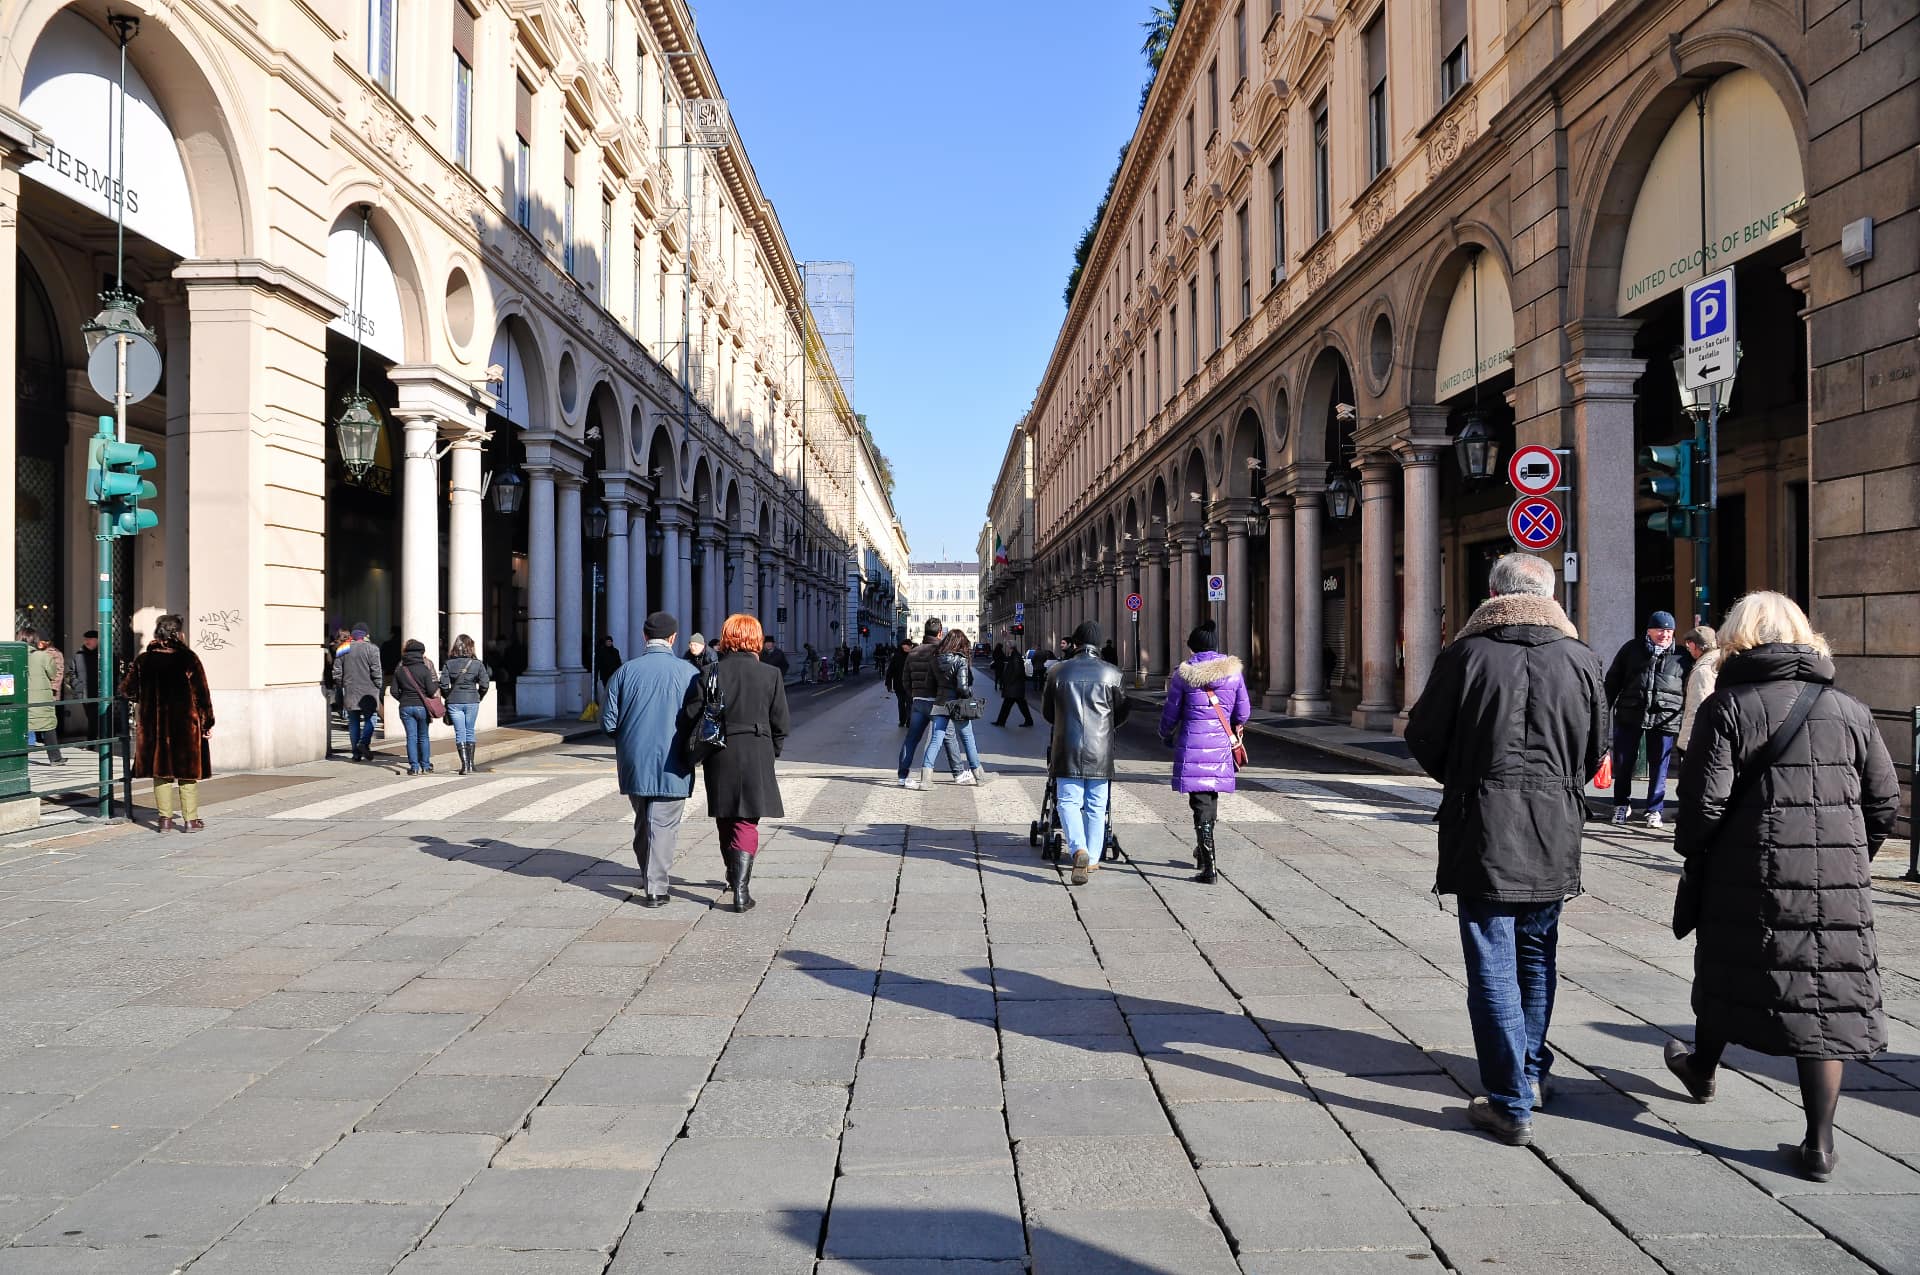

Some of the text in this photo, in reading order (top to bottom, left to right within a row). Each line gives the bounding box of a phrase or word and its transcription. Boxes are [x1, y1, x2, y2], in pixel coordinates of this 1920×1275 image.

[1626, 269, 1666, 301] UNITED
[1669, 242, 1718, 279] COLORS
[1721, 231, 1740, 253] OF
[1700, 297, 1719, 336] P
[1698, 349, 1720, 362] Castello
[1705, 341, 1715, 349] San
[1715, 336, 1730, 346] Carlo
[1439, 373, 1460, 393] UNITED
[1488, 354, 1497, 369] OF
